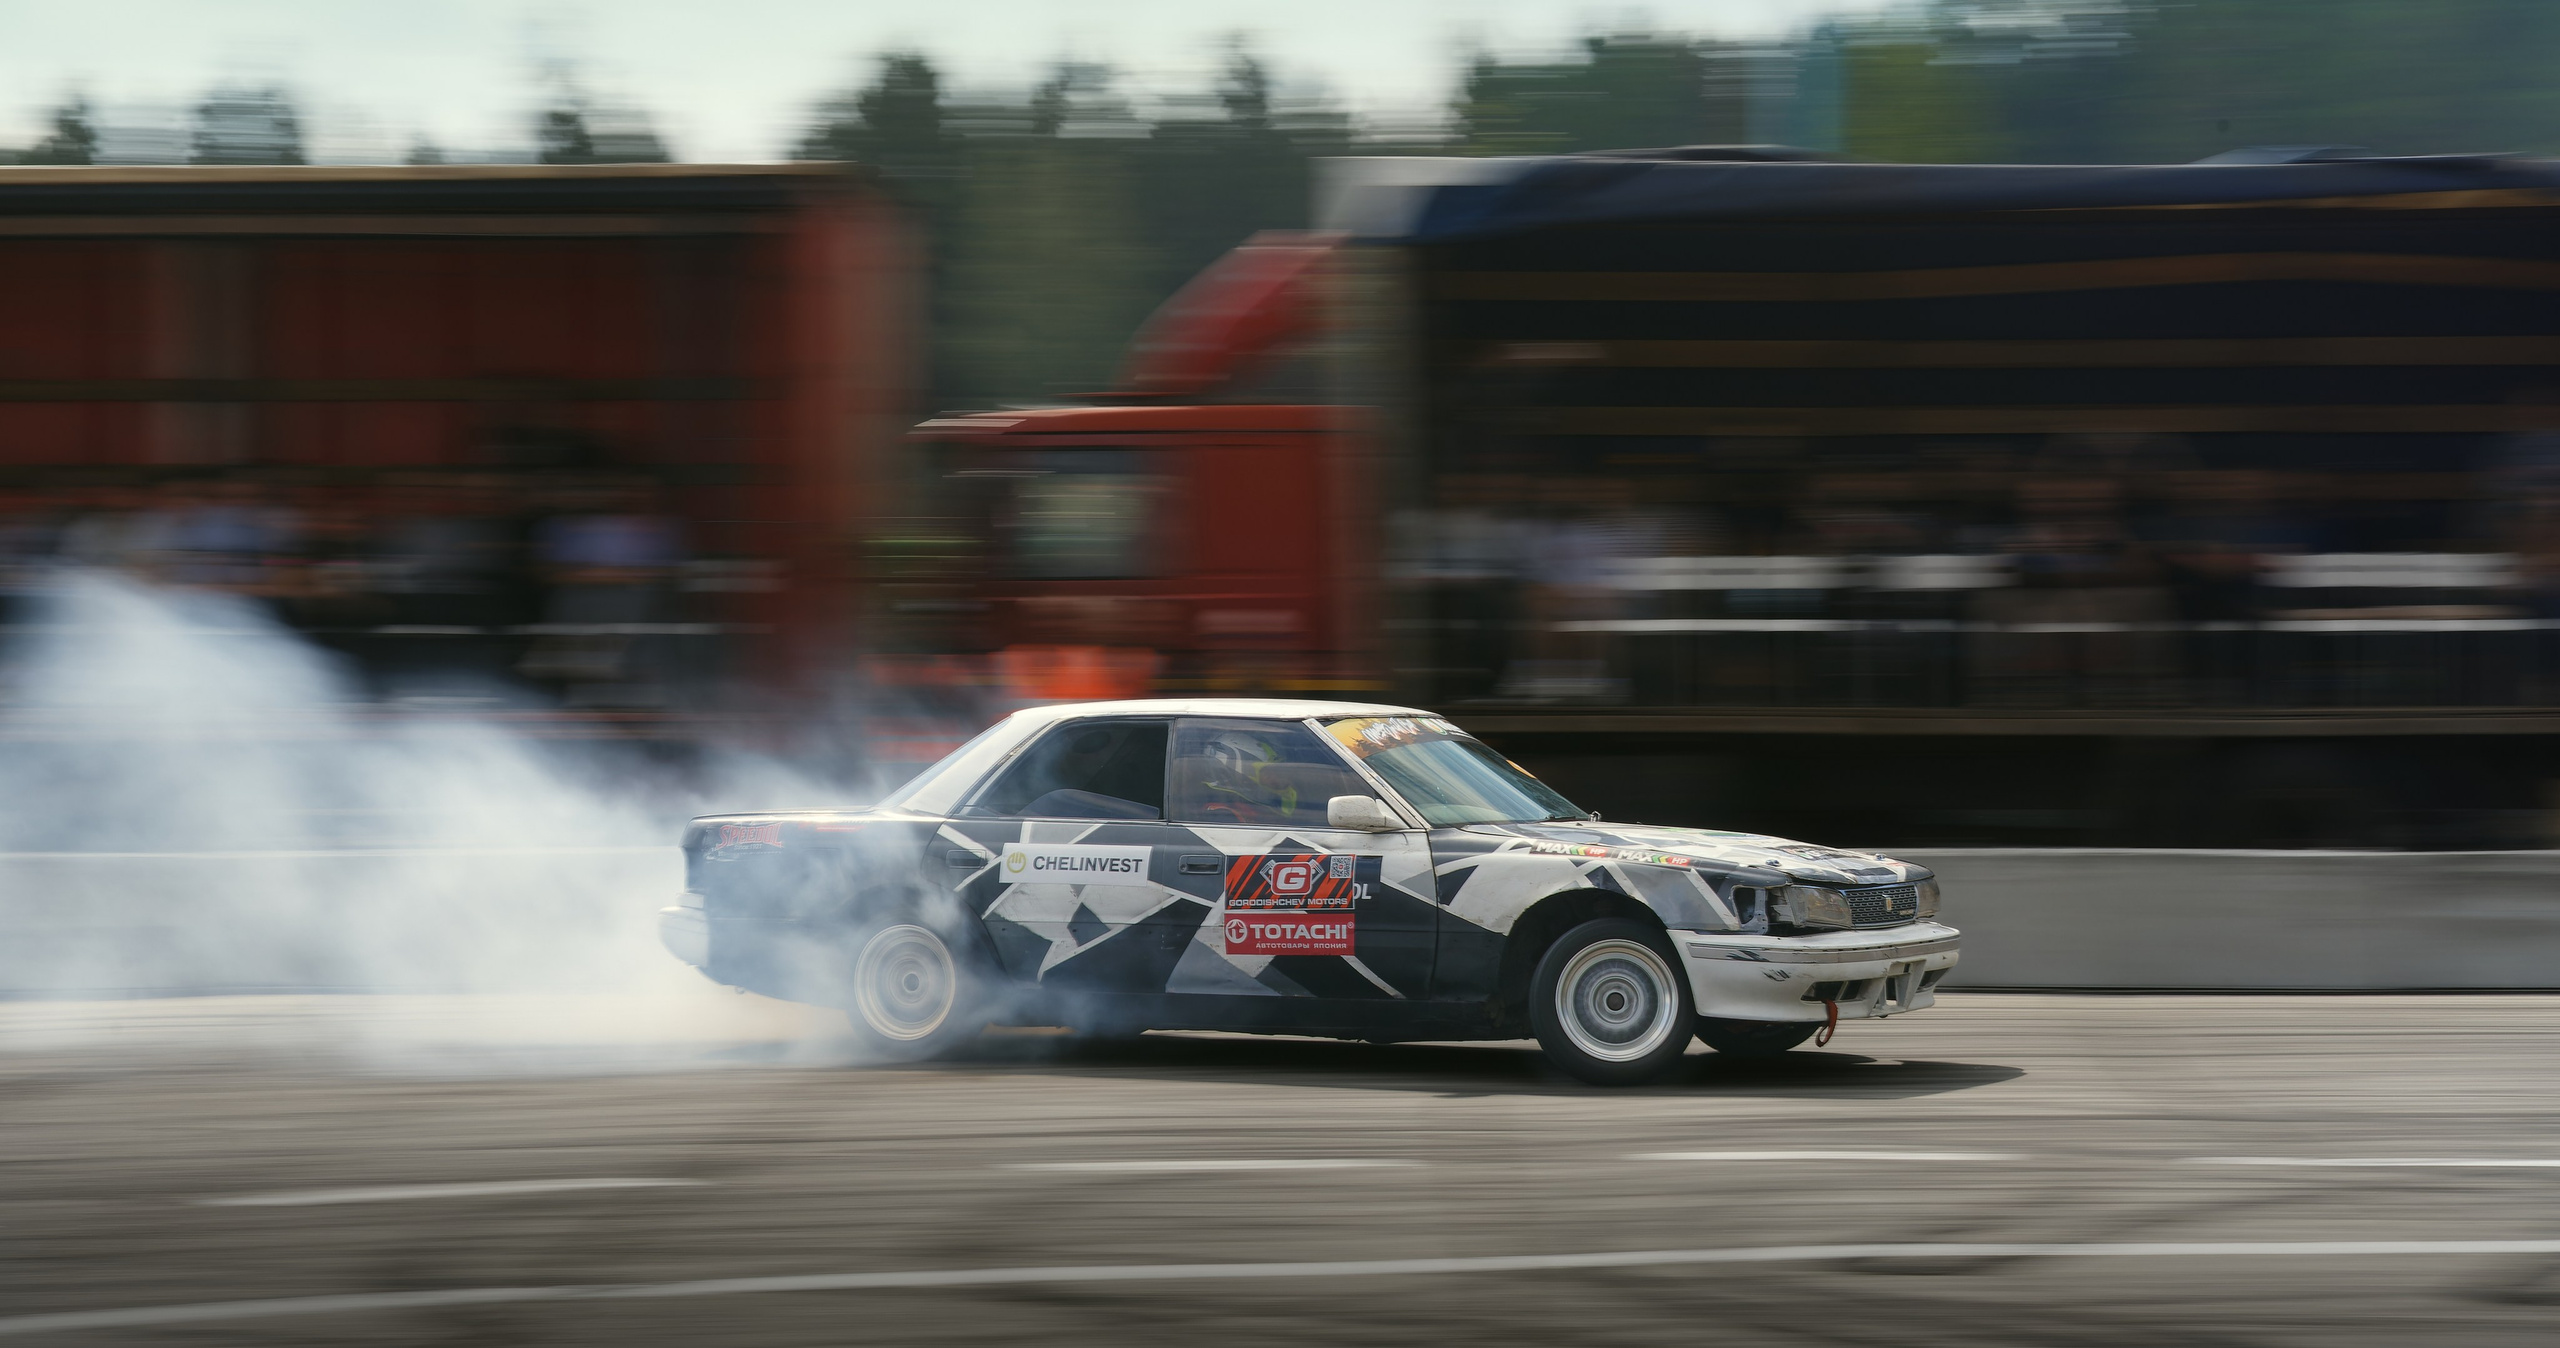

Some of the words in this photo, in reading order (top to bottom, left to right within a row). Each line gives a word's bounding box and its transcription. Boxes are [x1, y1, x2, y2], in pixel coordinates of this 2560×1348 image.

[1536, 842, 1572, 855] MAX
[1589, 847, 1606, 855] HP
[1033, 856, 1143, 873] CHELINVEST
[1617, 850, 1653, 863] MAX
[1671, 857, 1688, 865] HP
[1277, 866, 1307, 890] G
[1228, 898, 1306, 907] GORODISHCHEV
[1307, 897, 1348, 906] MOTORS
[1249, 924, 1347, 940] TOTACHI
